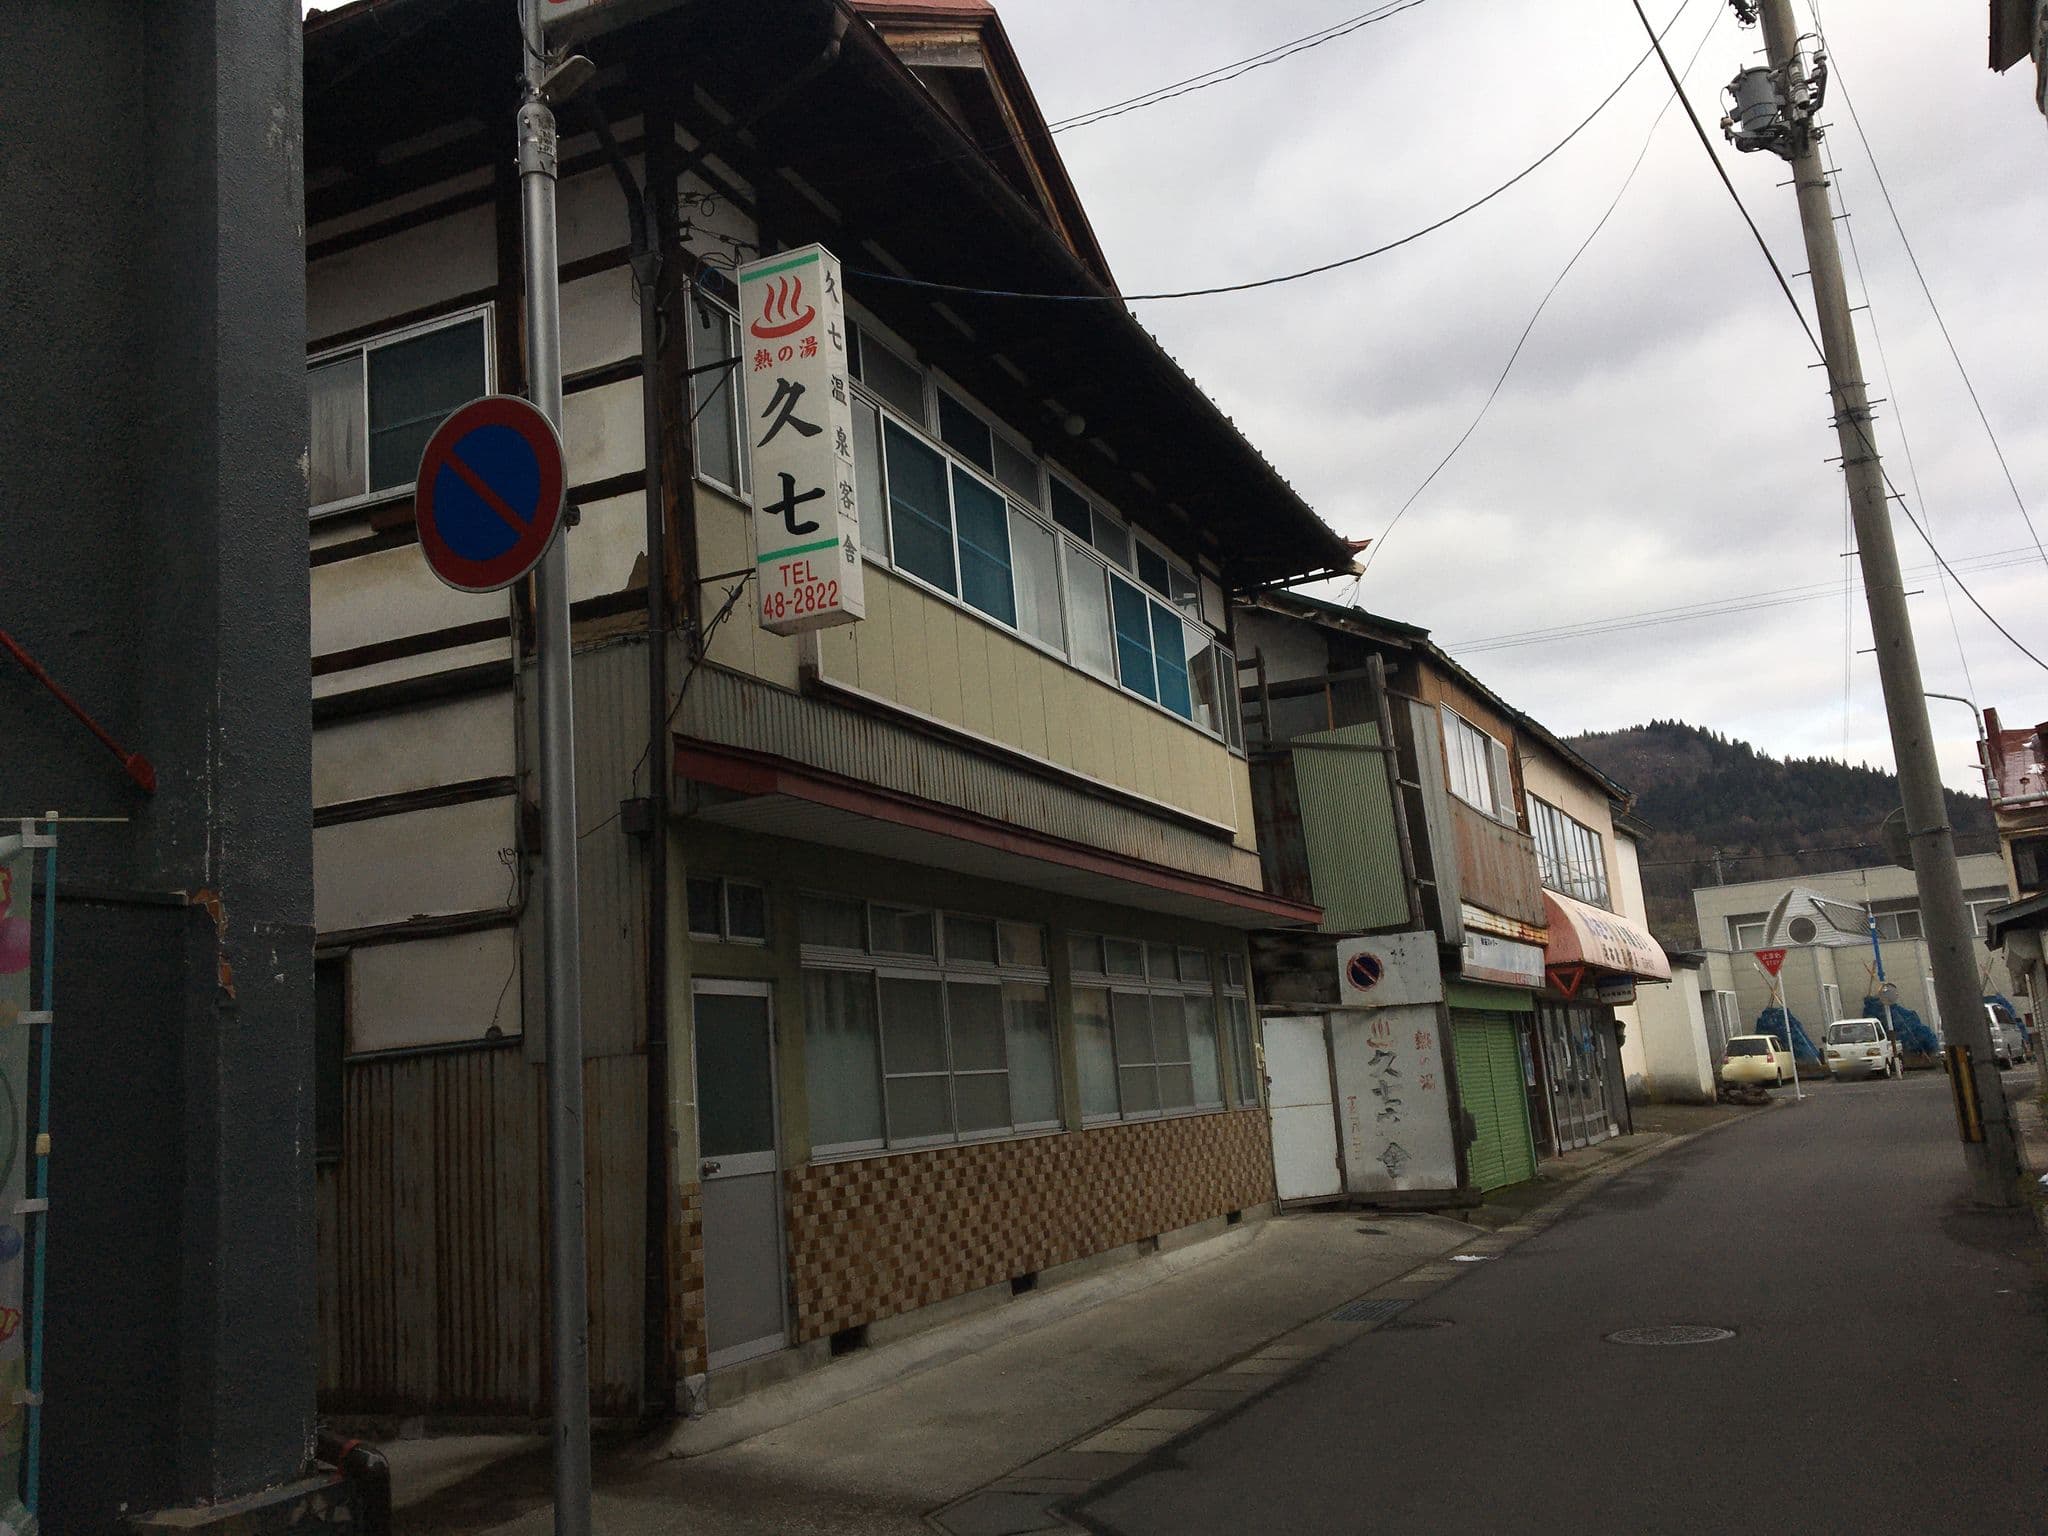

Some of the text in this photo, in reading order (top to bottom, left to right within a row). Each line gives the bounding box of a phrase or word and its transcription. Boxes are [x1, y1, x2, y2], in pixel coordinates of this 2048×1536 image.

[754, 336, 819, 372] 熱の湯
[825, 270, 857, 564] 久七温泉客舎
[757, 377, 826, 536] 久七
[779, 559, 819, 588] TEL
[763, 579, 839, 620] 48-2822
